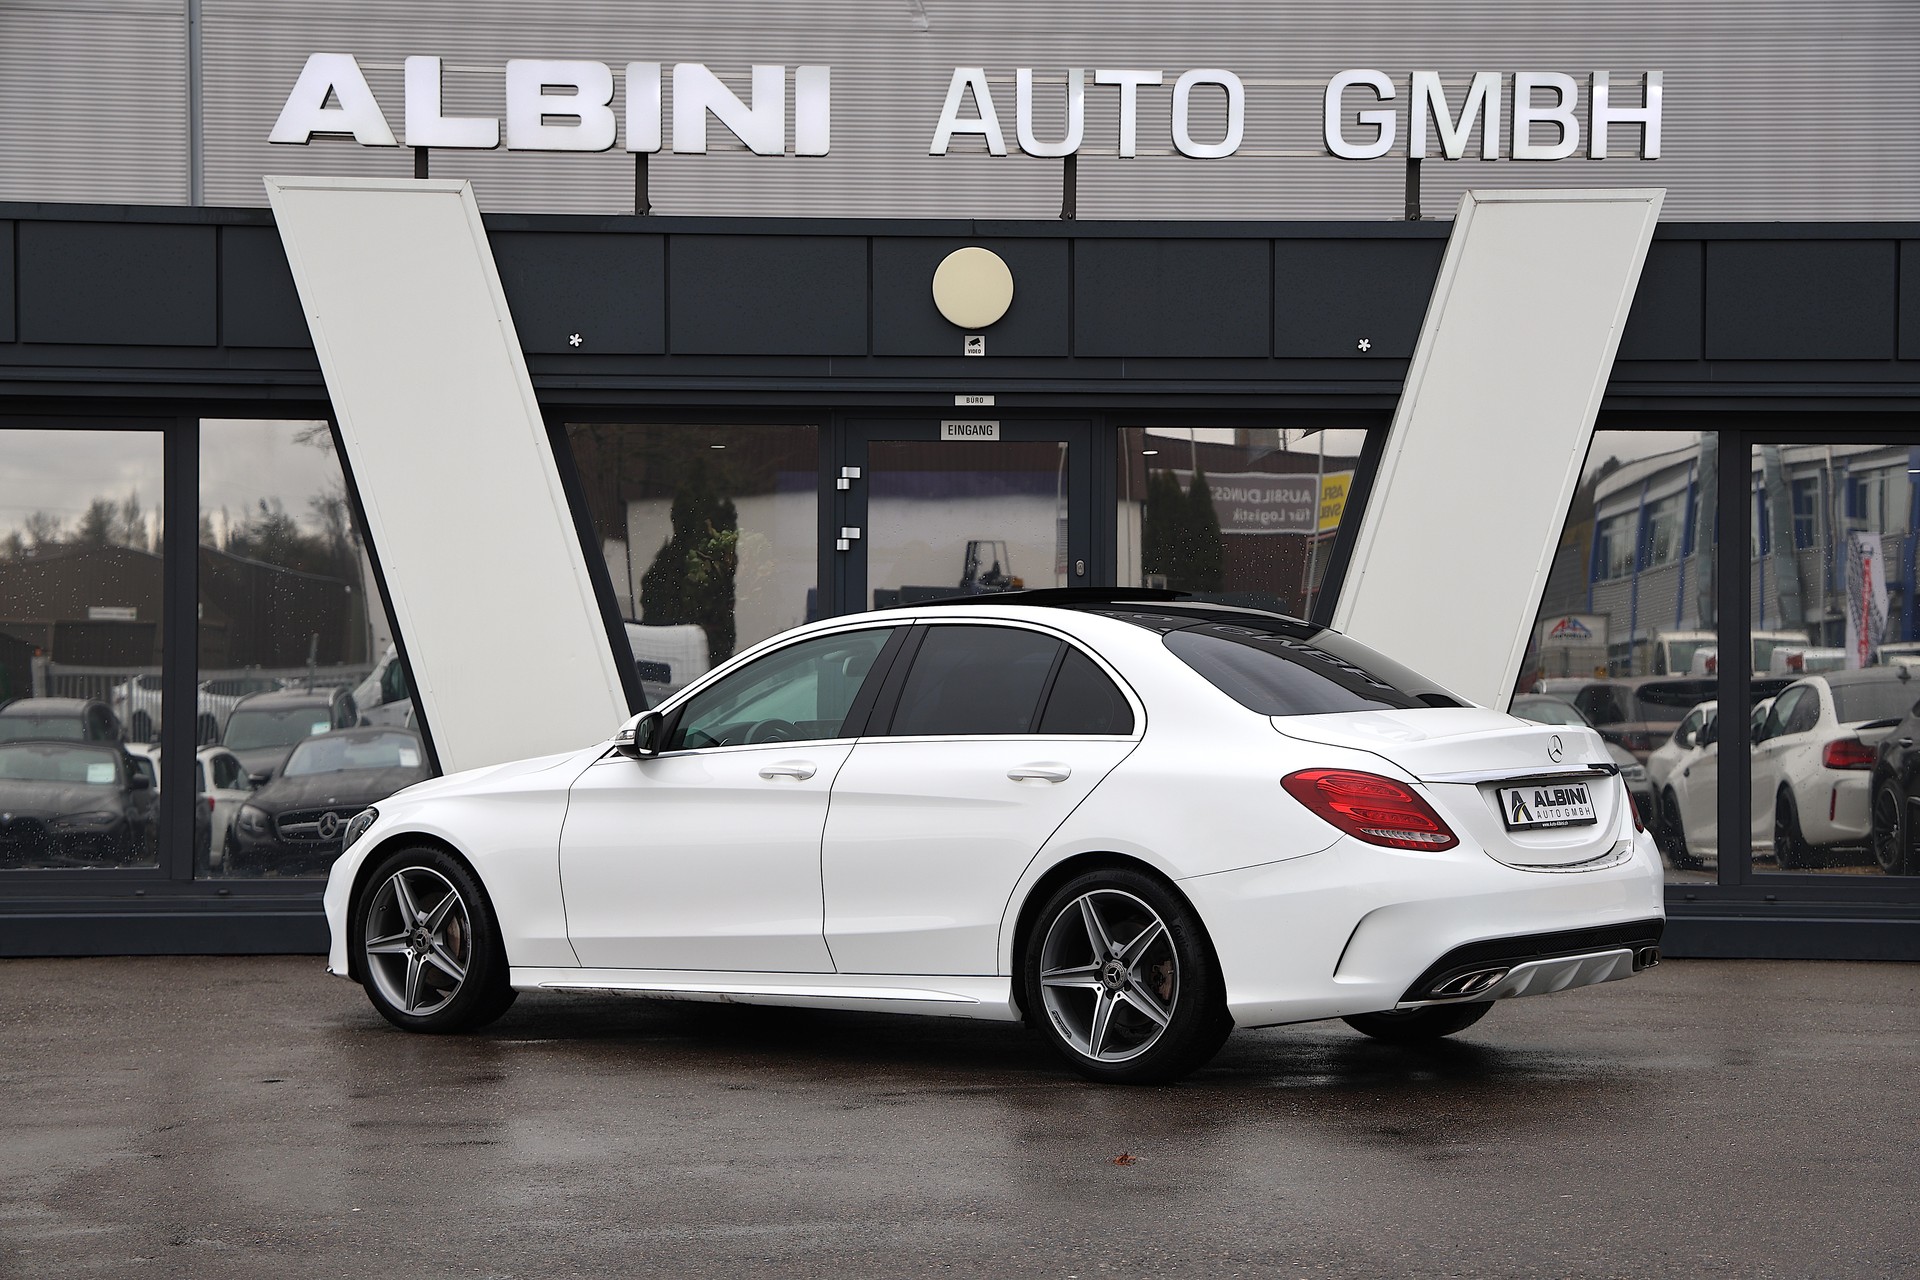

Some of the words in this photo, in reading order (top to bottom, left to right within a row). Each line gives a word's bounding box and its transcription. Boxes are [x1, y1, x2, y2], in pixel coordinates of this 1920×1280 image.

[267, 52, 831, 157] ALBINI
[929, 67, 1246, 159] AUTO
[1323, 69, 1664, 161] GMBH
[966, 396, 984, 404] BÜRO
[948, 424, 993, 436] EINGANG
[1534, 788, 1587, 807] ALBINI
[1537, 809, 1561, 819] AUTO
[1564, 807, 1591, 817] GMBH
